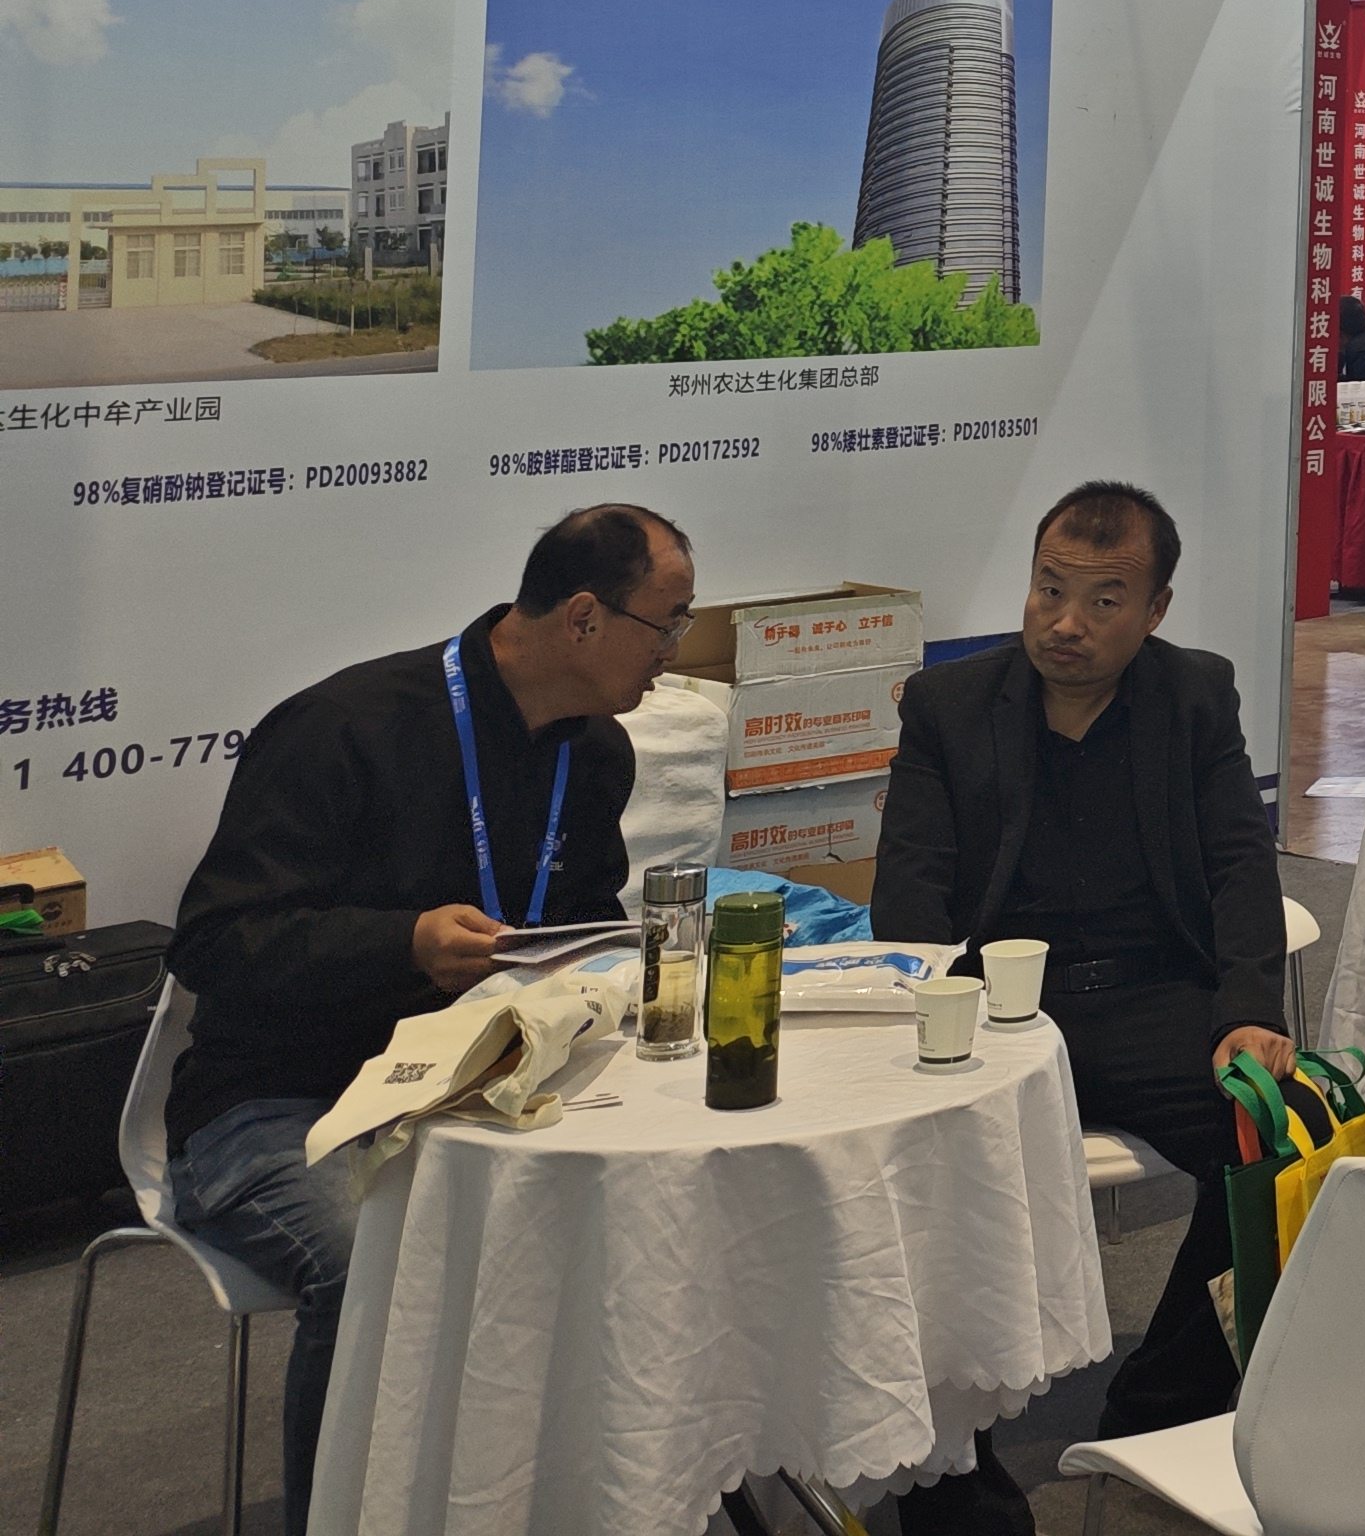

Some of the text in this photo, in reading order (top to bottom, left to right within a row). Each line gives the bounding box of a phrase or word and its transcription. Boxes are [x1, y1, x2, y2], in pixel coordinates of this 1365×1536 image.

[1306, 74, 1337, 476] 河南世诚生物科技有限公司
[668, 366, 879, 398] 郑州农达生化集团总部
[0, 396, 222, 431] 生化中牟产业园
[14, 759, 30, 790] 1
